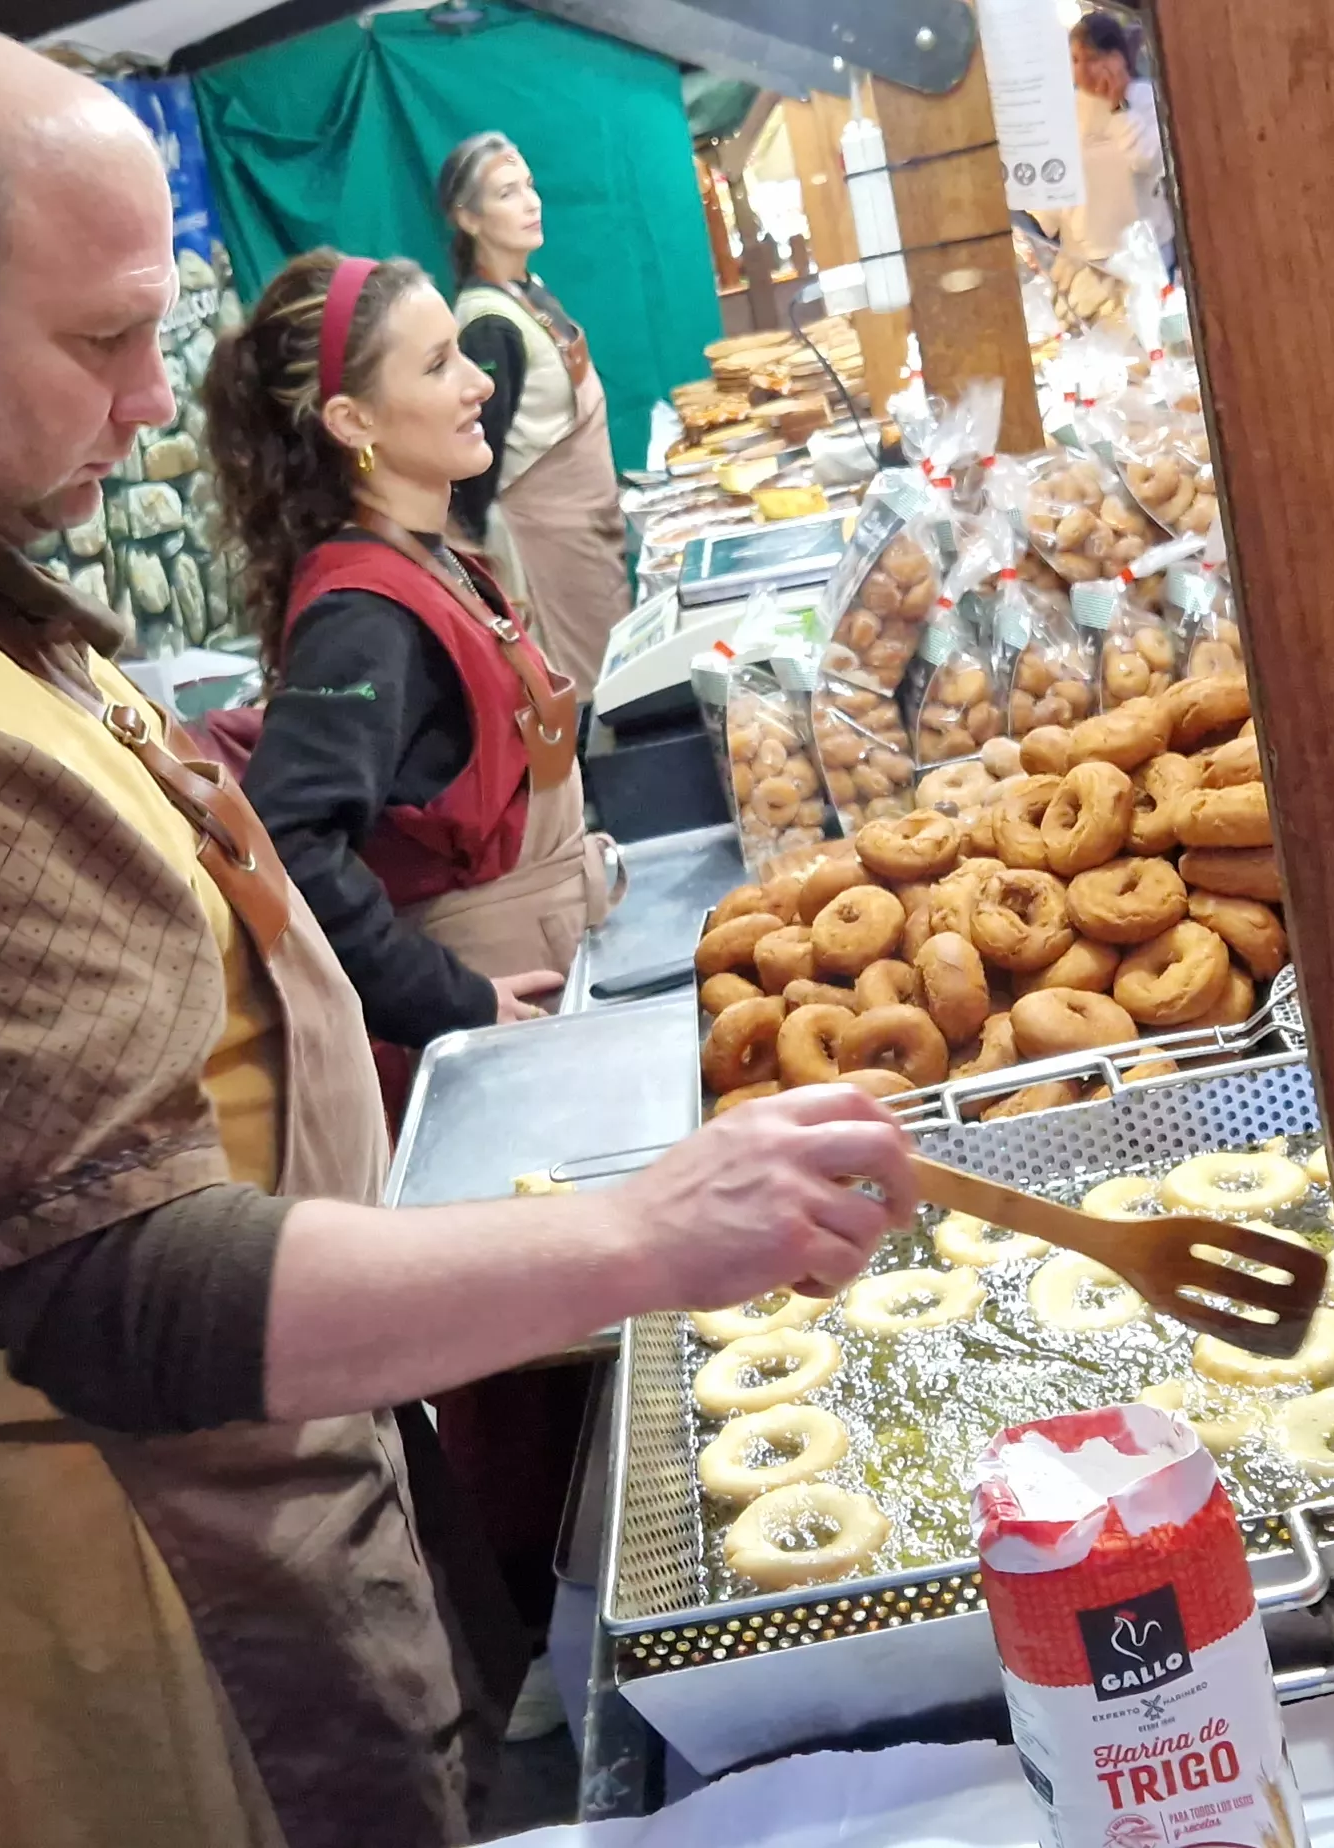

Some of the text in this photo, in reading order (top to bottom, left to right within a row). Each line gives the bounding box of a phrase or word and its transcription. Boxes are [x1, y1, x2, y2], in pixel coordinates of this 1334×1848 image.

[1101, 1652, 1183, 1691] GALLO
[1092, 1707, 1140, 1722] EXPERTO
[1093, 1716, 1229, 1769] Harina de
[1097, 1740, 1240, 1810] TRIGO
